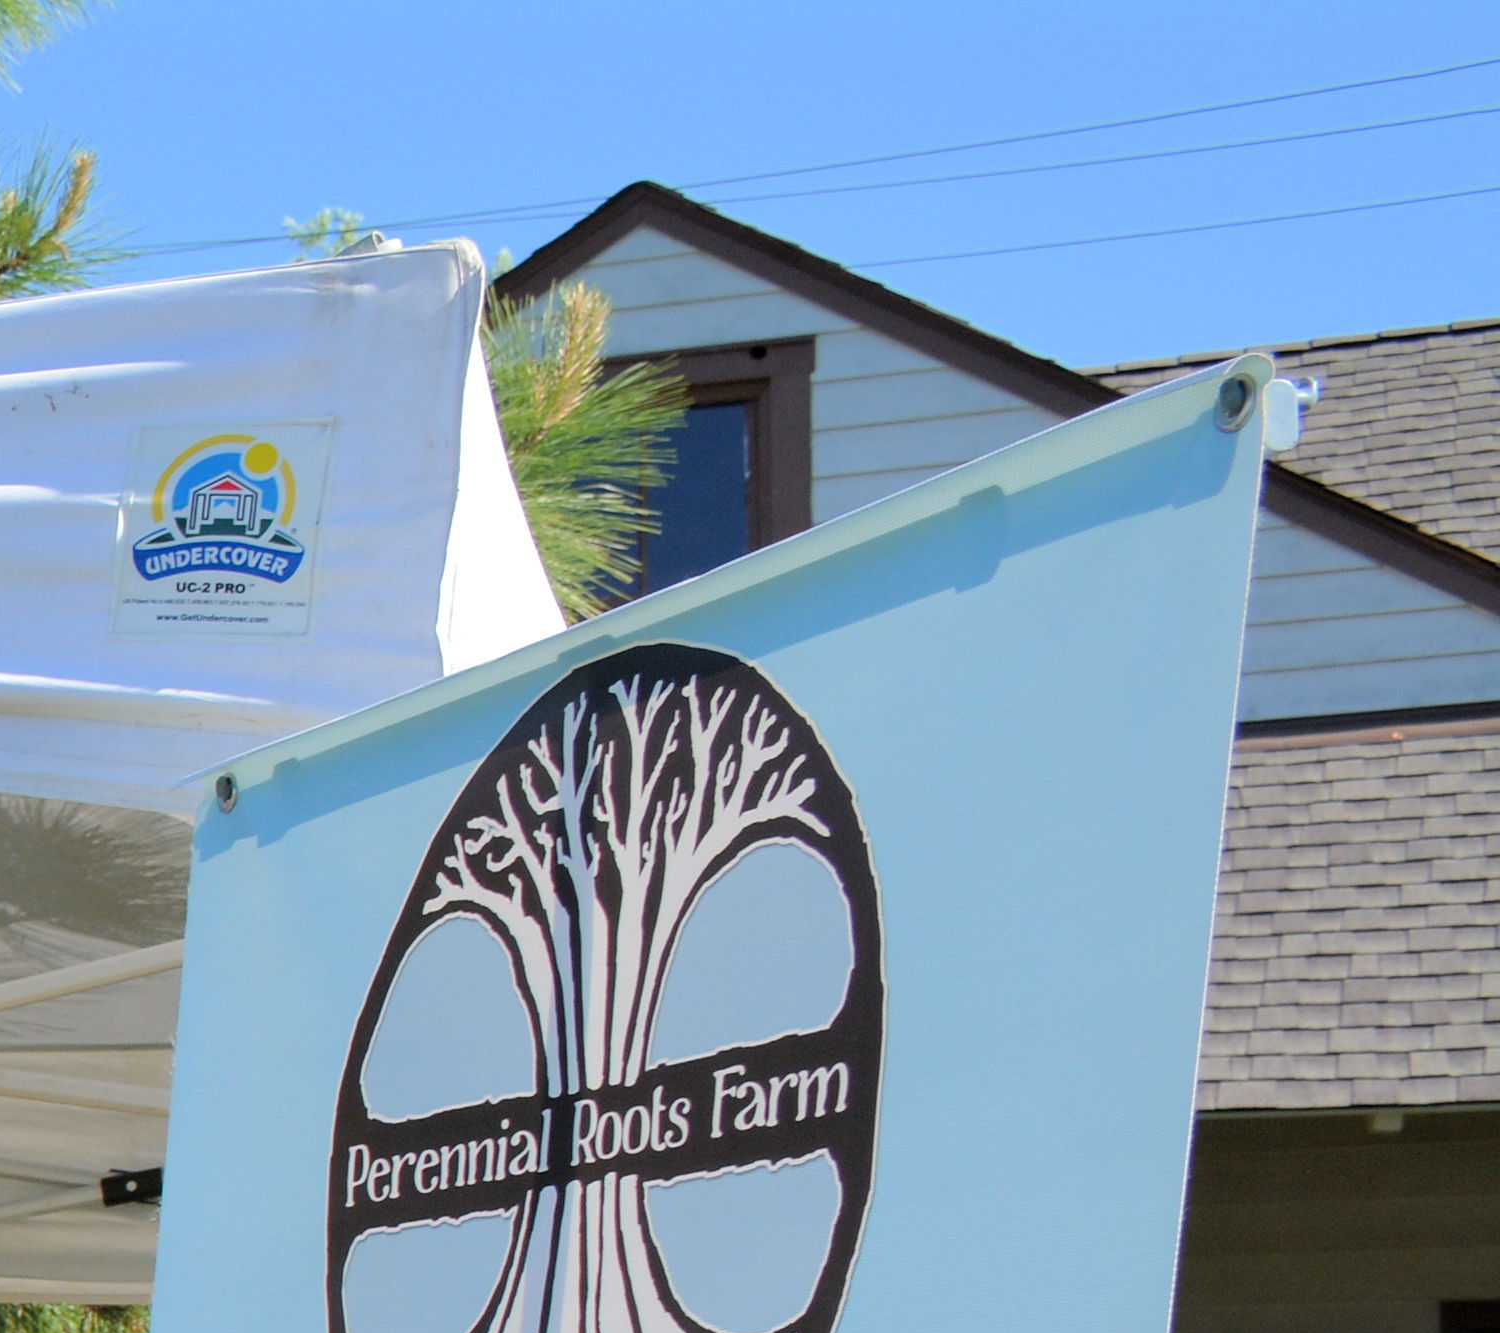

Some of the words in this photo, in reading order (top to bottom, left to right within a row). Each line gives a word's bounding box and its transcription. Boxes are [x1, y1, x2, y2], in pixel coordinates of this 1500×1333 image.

[145, 546, 289, 577] UNDERCOVER
[175, 582, 211, 594] UC-2
[214, 582, 246, 594] PRO
[156, 613, 269, 624] www.GetUndercover.com
[344, 1107, 552, 1208] Perennial
[569, 1086, 691, 1167] Roots
[710, 1059, 851, 1140] Farm
